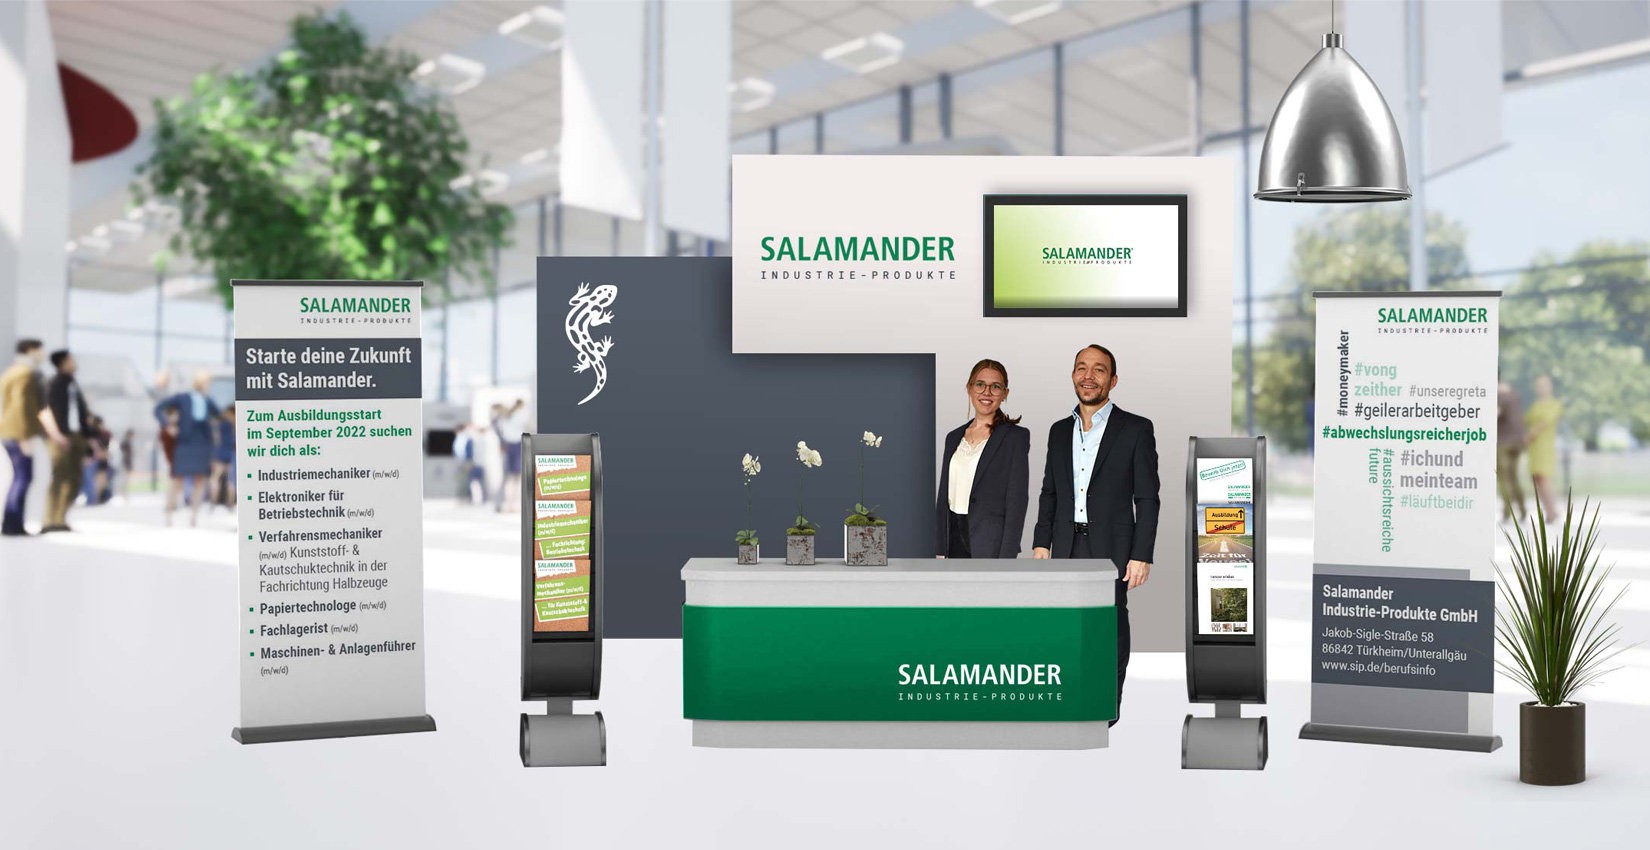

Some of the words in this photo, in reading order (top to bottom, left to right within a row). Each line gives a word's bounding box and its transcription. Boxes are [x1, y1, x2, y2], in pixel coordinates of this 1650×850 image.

[760, 235, 955, 262] SALAMANDER
[1042, 247, 1132, 259] SALAMANDER
[760, 270, 956, 280] INDUSTRIE-PRODUKTE
[300, 297, 411, 313] SALAMANDER
[1378, 308, 1488, 324] SALAMANDER
[246, 348, 296, 364] Starte
[300, 346, 346, 364] deine
[349, 346, 412, 364] Zukunft
[1336, 330, 1351, 416] #moneymaker
[1354, 362, 1398, 380] #vong
[246, 372, 272, 389] mit
[277, 370, 377, 388] Salamander.
[1354, 382, 1402, 397] zeither
[1409, 384, 1486, 400] #unseregreta
[246, 410, 274, 422] Zum
[277, 408, 382, 424] Ausbildungsstart
[1354, 402, 1480, 422] #geilerarbeitgeber
[247, 428, 262, 440] im
[266, 426, 332, 442] September
[336, 426, 366, 438] 2022
[370, 425, 412, 436] suchen
[1322, 425, 1487, 444] #abwechslungsreicherjob
[247, 446, 266, 457] wir
[270, 445, 296, 456] dich
[299, 444, 321, 456] als:
[1368, 448, 1381, 484] future
[1400, 450, 1464, 468] #ichund
[258, 468, 371, 481] Industriemechaniker
[372, 470, 400, 479] (m/w/d)
[1400, 473, 1478, 490] meinteam
[258, 490, 326, 504] Elektroniker
[328, 490, 344, 502] für
[1382, 448, 1395, 552] #aussichtsreiche
[1400, 495, 1474, 510] #läuftbeidir
[258, 506, 346, 520] Betriebstechnik
[347, 508, 374, 518] (m/w/d)
[258, 528, 383, 542] Verfahrensmechaniker
[259, 551, 288, 560] (m/w/d)
[290, 544, 349, 558] Kunststoff-
[352, 544, 360, 556] &
[260, 561, 355, 576] Kautschuktechnik
[358, 560, 368, 572] in
[370, 560, 388, 572] der
[260, 578, 330, 593] Fachrichtung
[332, 577, 388, 590] Halbzeuge
[1322, 584, 1394, 600] Salamander
[260, 600, 357, 617] Papiertechnologe
[359, 601, 387, 611] (m/w/d)
[1322, 603, 1437, 621] Industrie-Produkte
[1440, 608, 1478, 622] GmbH
[260, 623, 328, 638] Fachlagerist
[331, 624, 358, 634] (m/w/d)
[1322, 626, 1418, 642] Jakob-Sigle-Straße
[1421, 632, 1434, 642] 58
[260, 646, 325, 660] Maschinen-
[328, 644, 336, 656] &
[339, 640, 416, 656] Anlagenführer
[1322, 643, 1354, 655] 86842
[1356, 645, 1468, 662] Türkheim/Unterallgäu
[260, 666, 289, 676] (m/w/d)
[898, 664, 1062, 686] SALAMANDER
[1322, 660, 1436, 676] www.sip.de/berufsinfo
[898, 692, 1062, 700] INDUSTRIE-PRODUKTE
